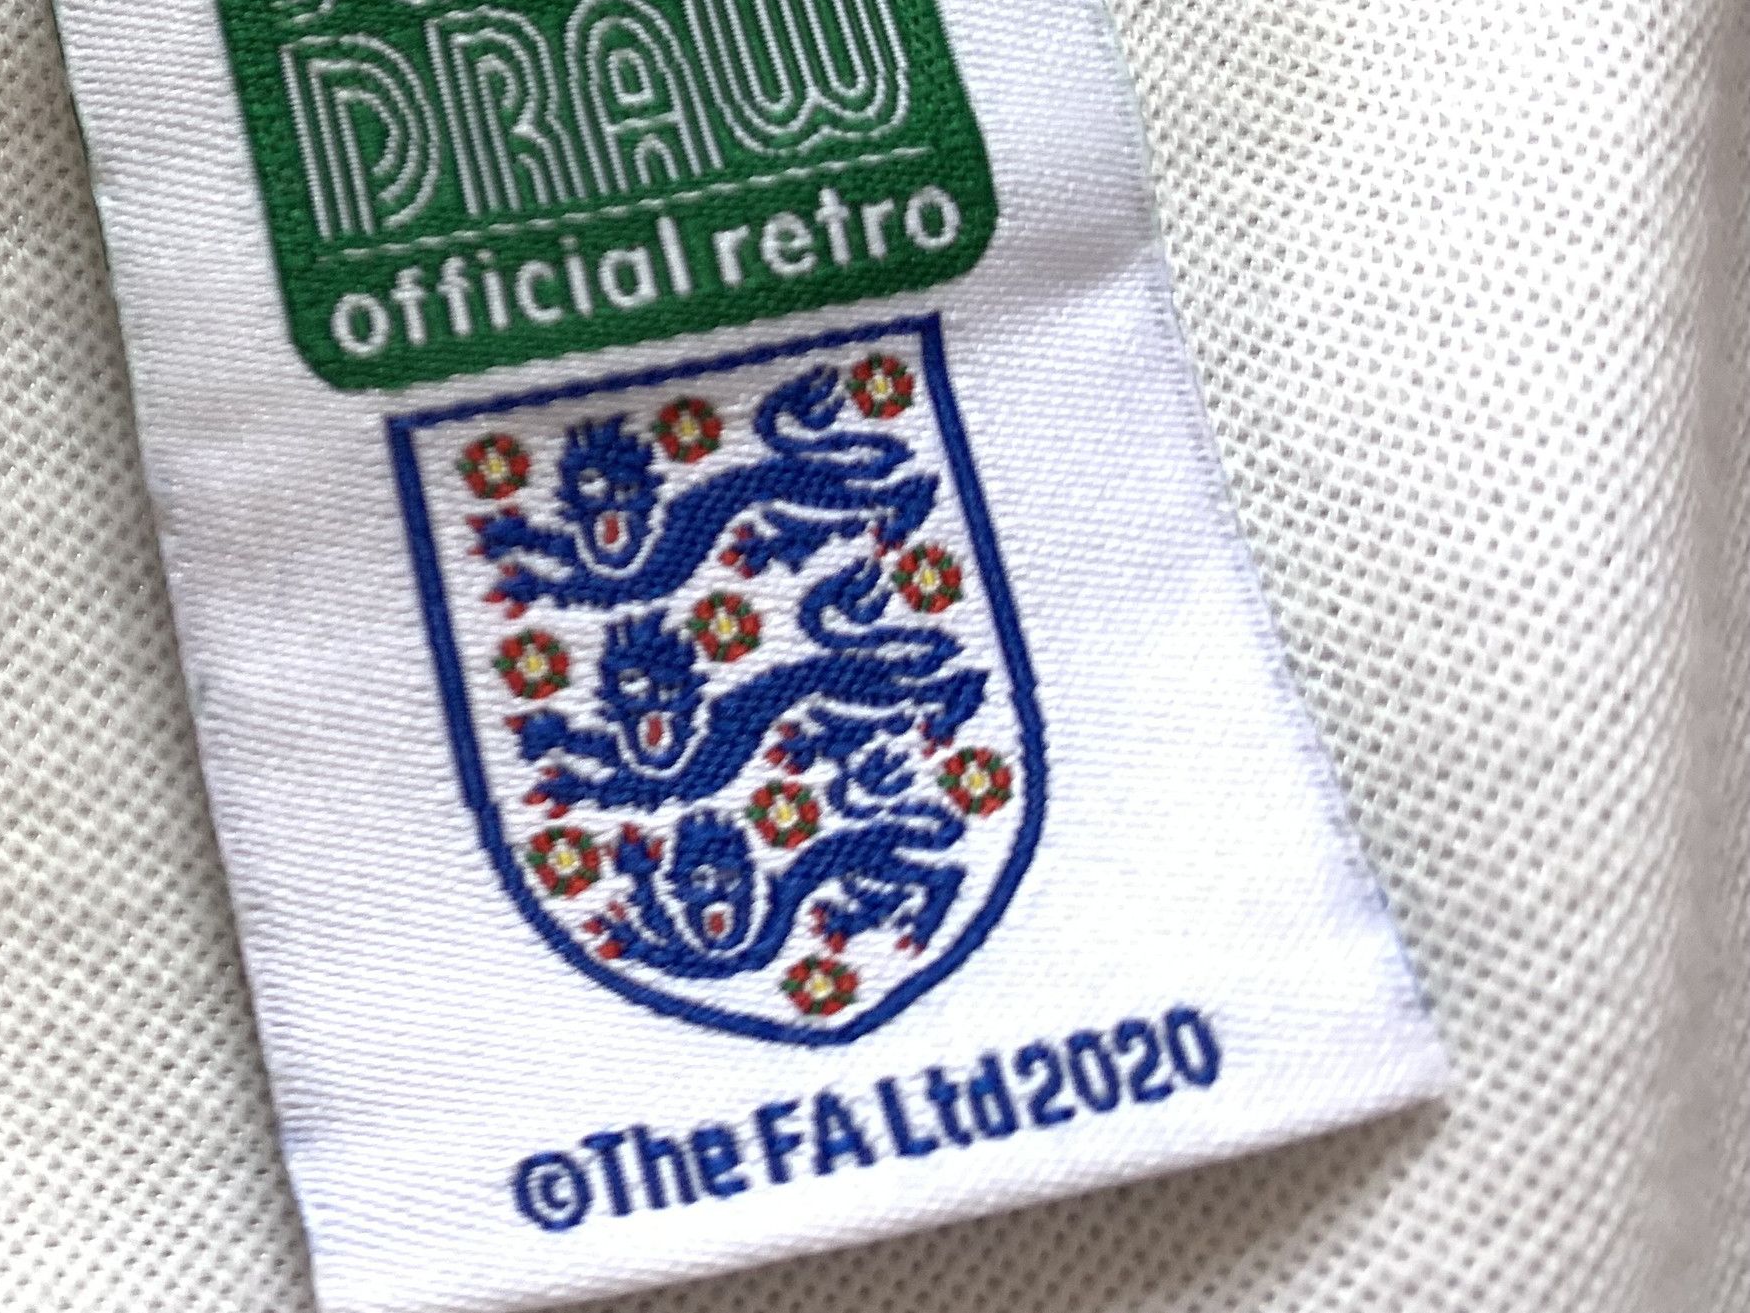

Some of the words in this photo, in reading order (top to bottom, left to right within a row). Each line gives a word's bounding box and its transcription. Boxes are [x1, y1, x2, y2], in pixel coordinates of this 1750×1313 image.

[331, 216, 692, 357] official
[715, 187, 962, 285] retro
[753, 1089, 876, 1184] FA
